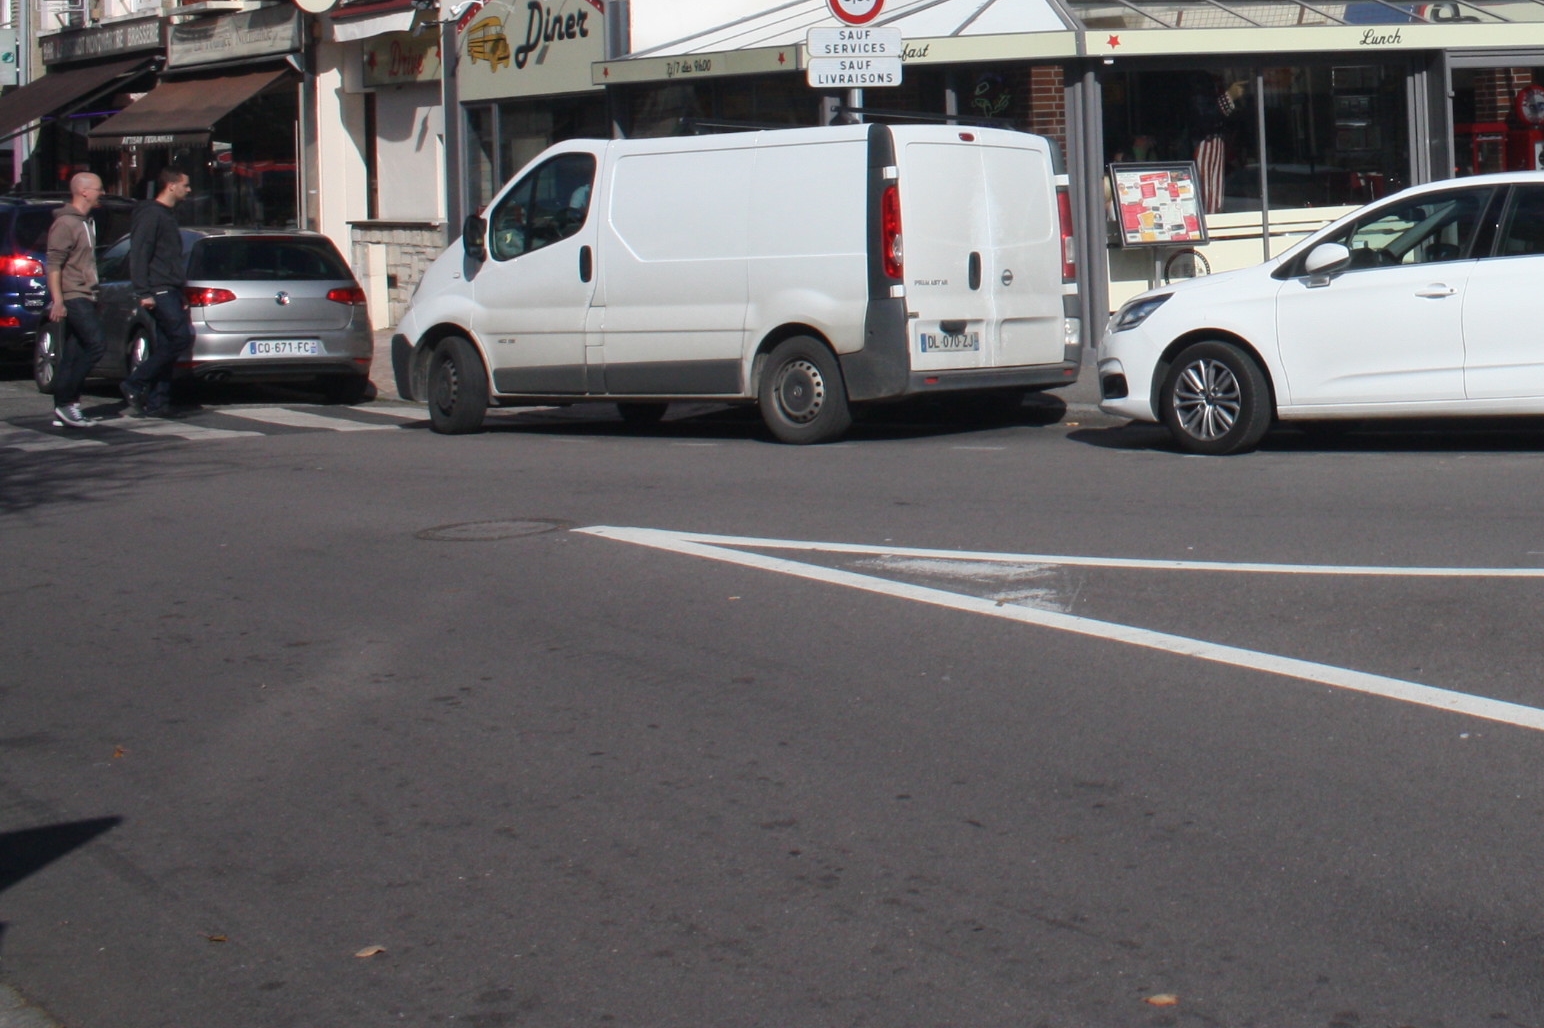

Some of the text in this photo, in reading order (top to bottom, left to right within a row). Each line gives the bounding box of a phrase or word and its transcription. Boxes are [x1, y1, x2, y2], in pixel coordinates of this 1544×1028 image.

[515, 0, 589, 69] Diner
[839, 30, 871, 40] SAUF
[1359, 28, 1402, 45] Lunch
[825, 43, 886, 54] SERVICES
[898, 43, 930, 62] fast
[840, 61, 872, 71] SAUF
[818, 73, 893, 84] LIVRAISONS
[928, 334, 974, 348] DL-070-ZJ
